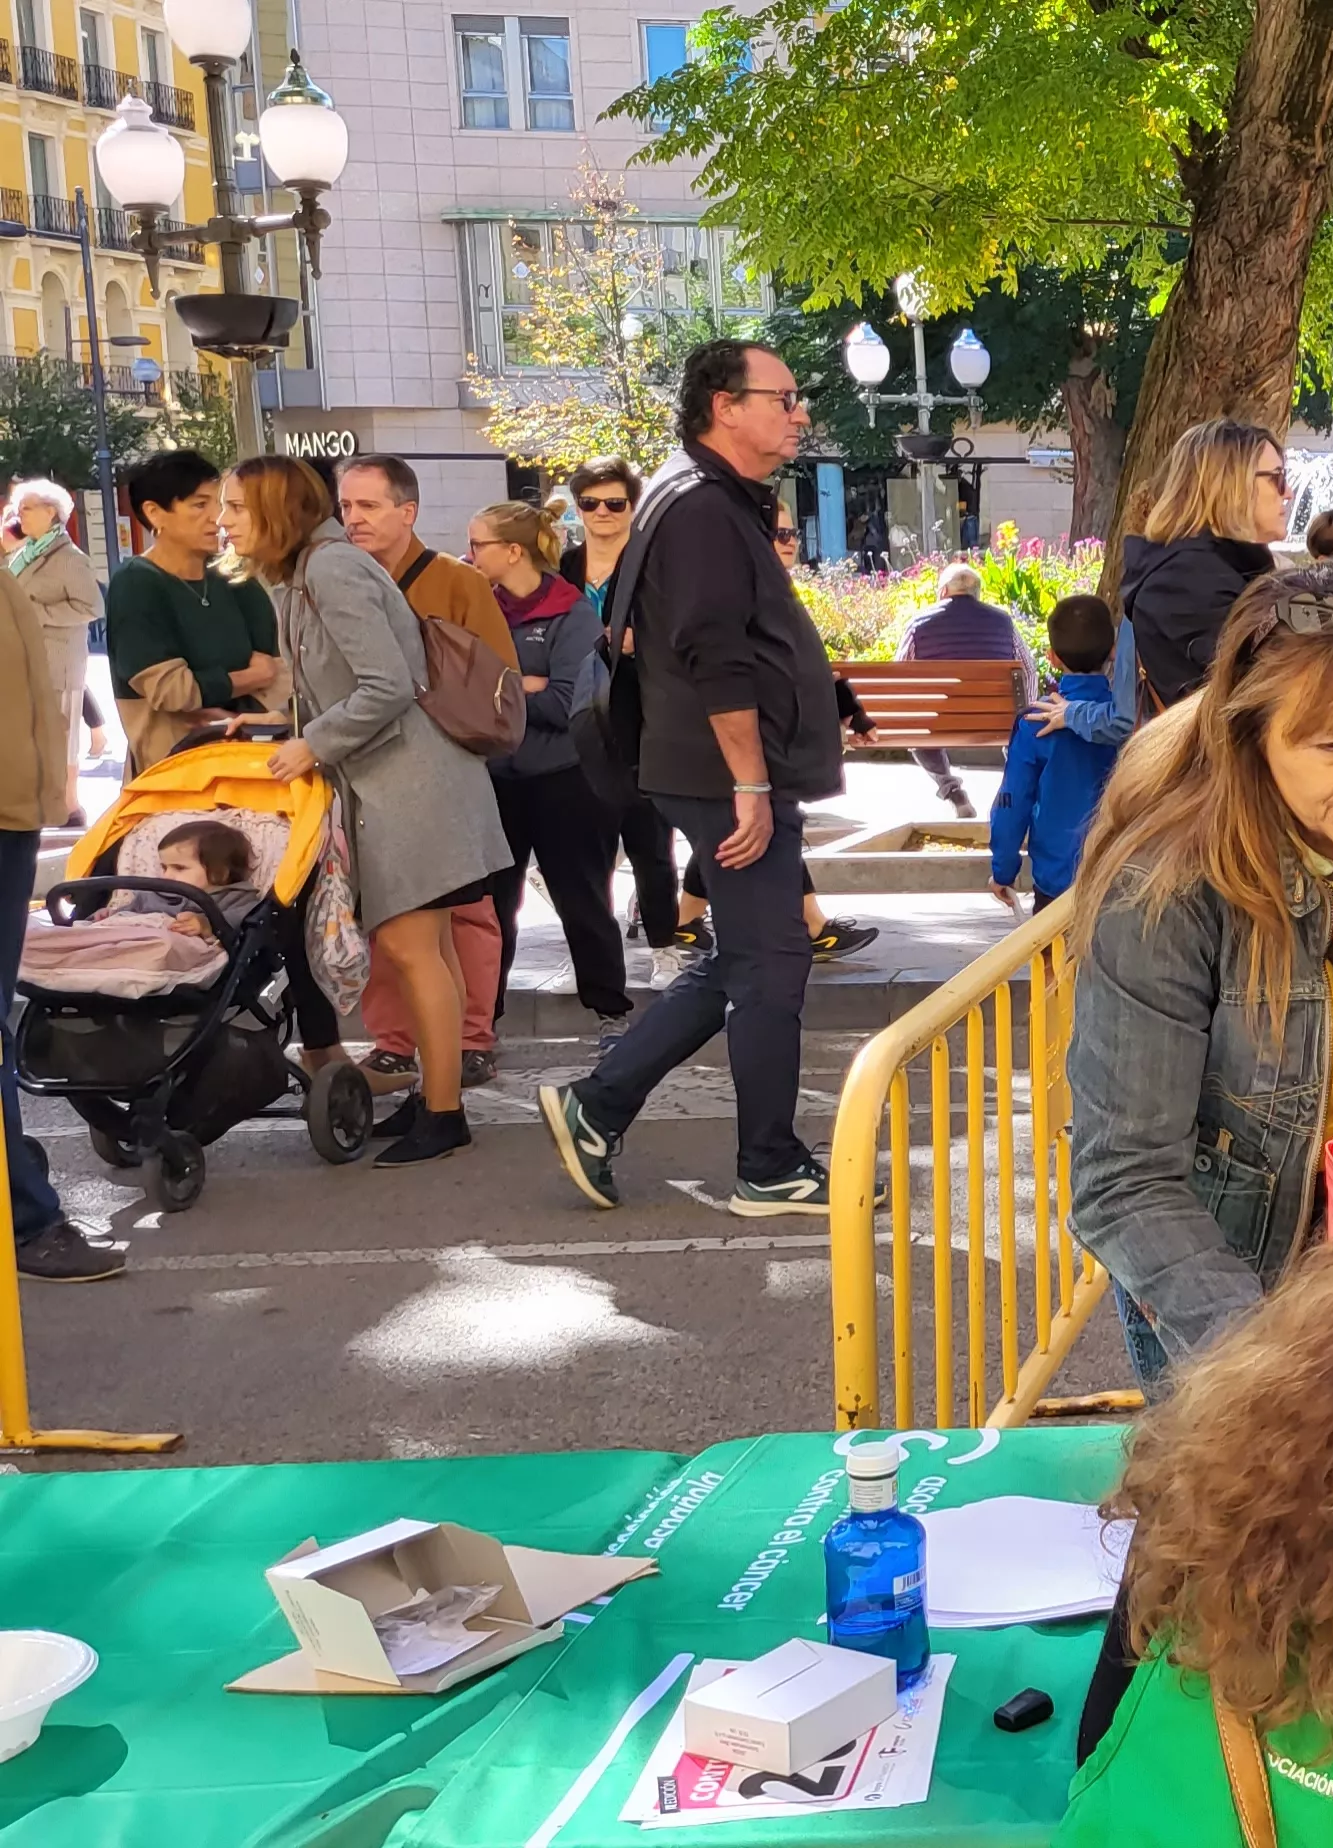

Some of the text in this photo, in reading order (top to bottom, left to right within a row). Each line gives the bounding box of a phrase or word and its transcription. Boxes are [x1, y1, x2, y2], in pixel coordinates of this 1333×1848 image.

[285, 430, 355, 458] MANGO
[783, 1468, 846, 1528] contra
[716, 1548, 790, 1612] cáncer
